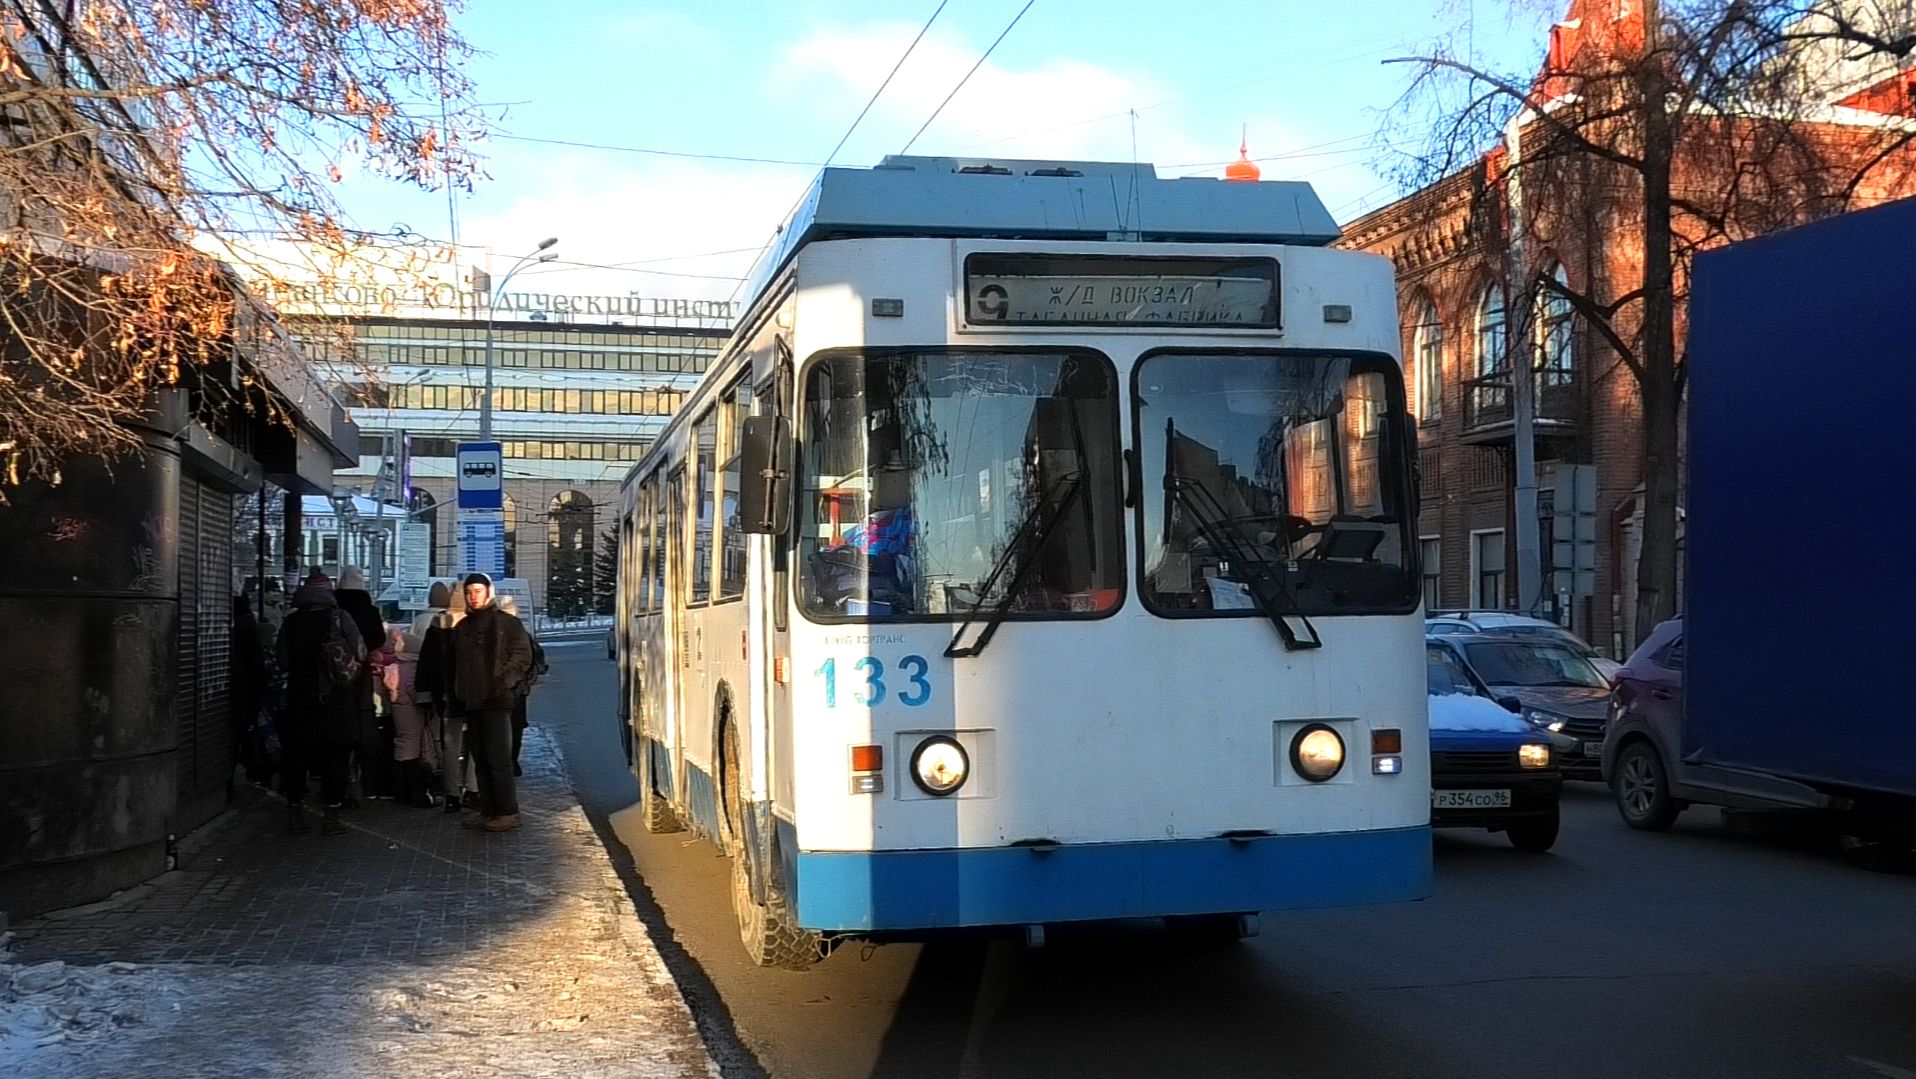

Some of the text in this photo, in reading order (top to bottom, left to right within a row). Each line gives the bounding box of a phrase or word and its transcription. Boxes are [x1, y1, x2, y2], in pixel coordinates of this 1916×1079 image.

[652, 298, 741, 320] инст
[977, 284, 1009, 320] 9
[1049, 285, 1193, 306] Ж/Д ВОКЗАЛ
[814, 655, 932, 708] 133
